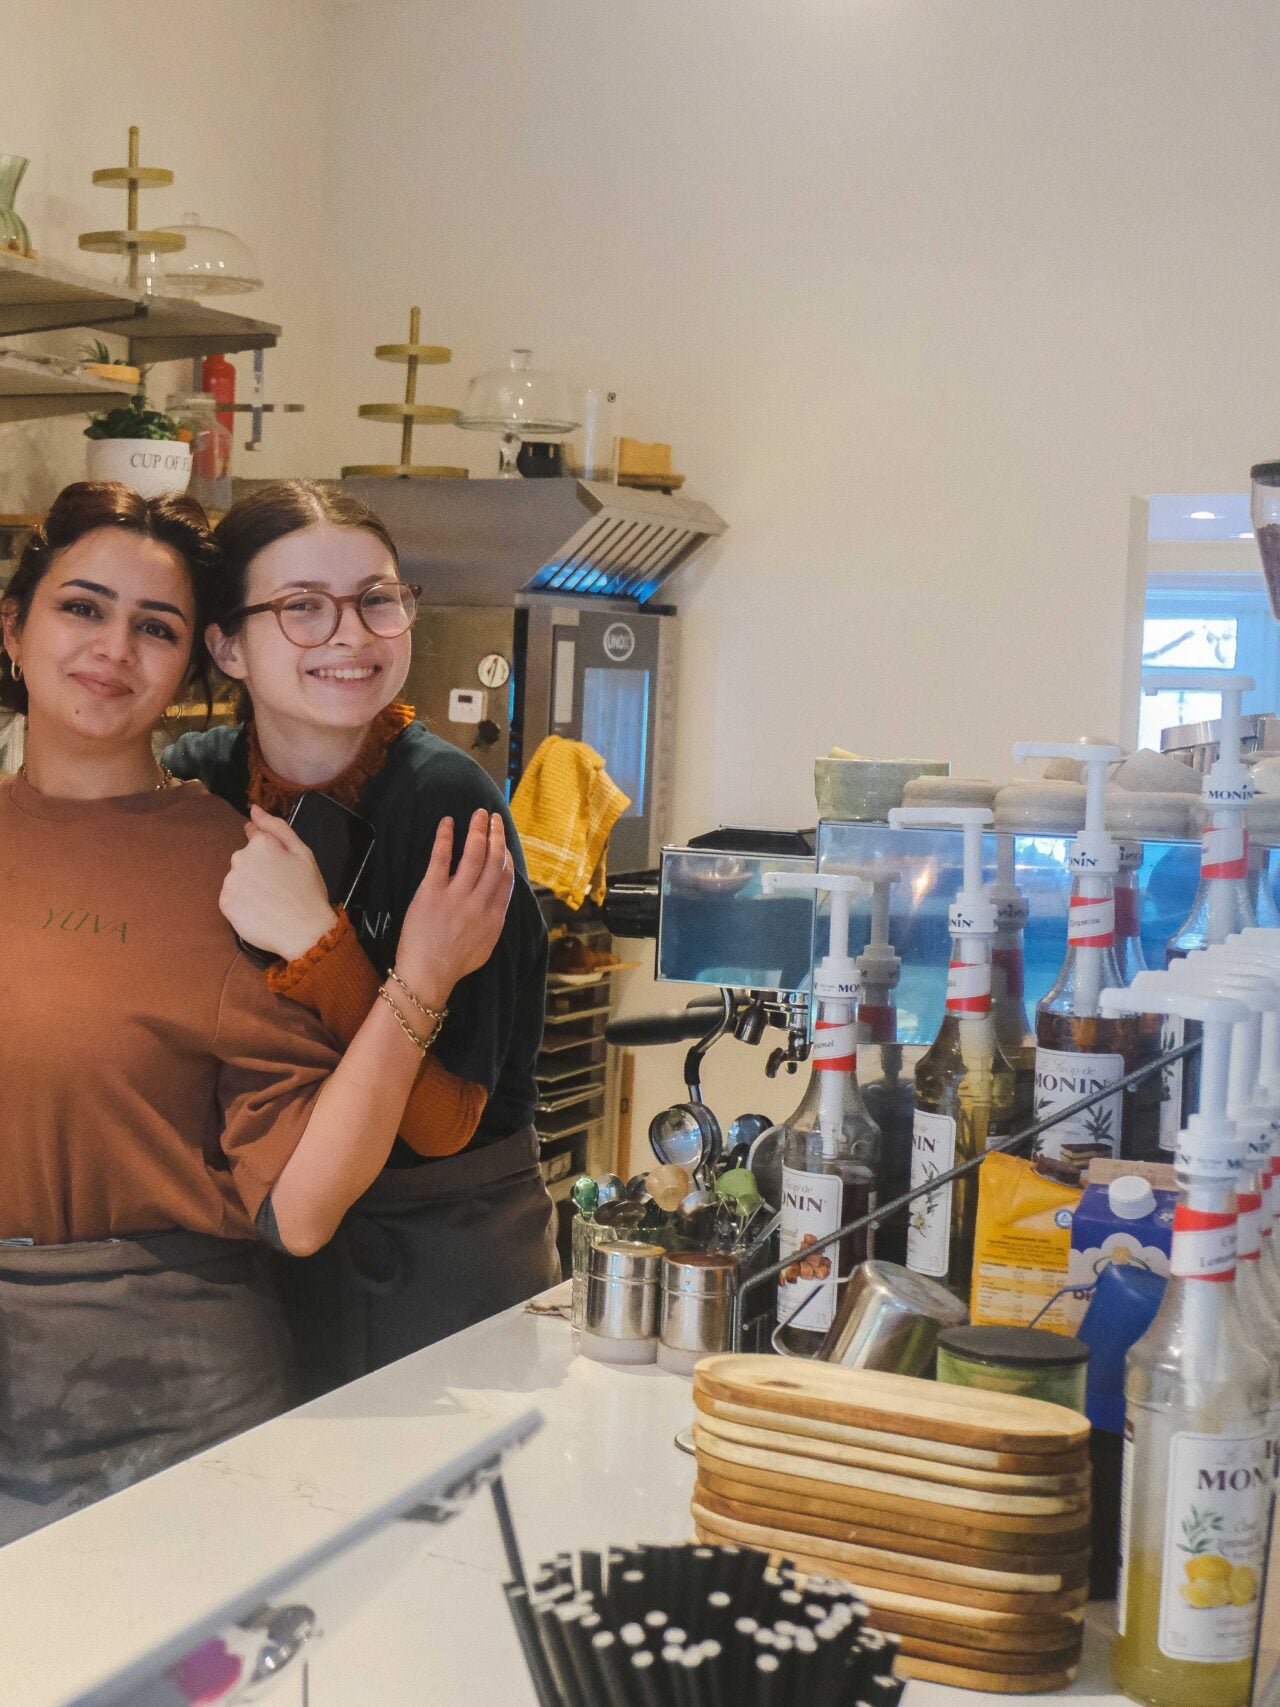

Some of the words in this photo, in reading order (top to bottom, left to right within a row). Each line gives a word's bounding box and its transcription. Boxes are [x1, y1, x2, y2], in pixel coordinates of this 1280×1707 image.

[130, 453, 161, 468] CUP
[165, 454, 180, 470] OF
[1208, 784, 1254, 800] MONIN
[1069, 851, 1096, 867] NIN
[1197, 1467, 1268, 1491] MON
